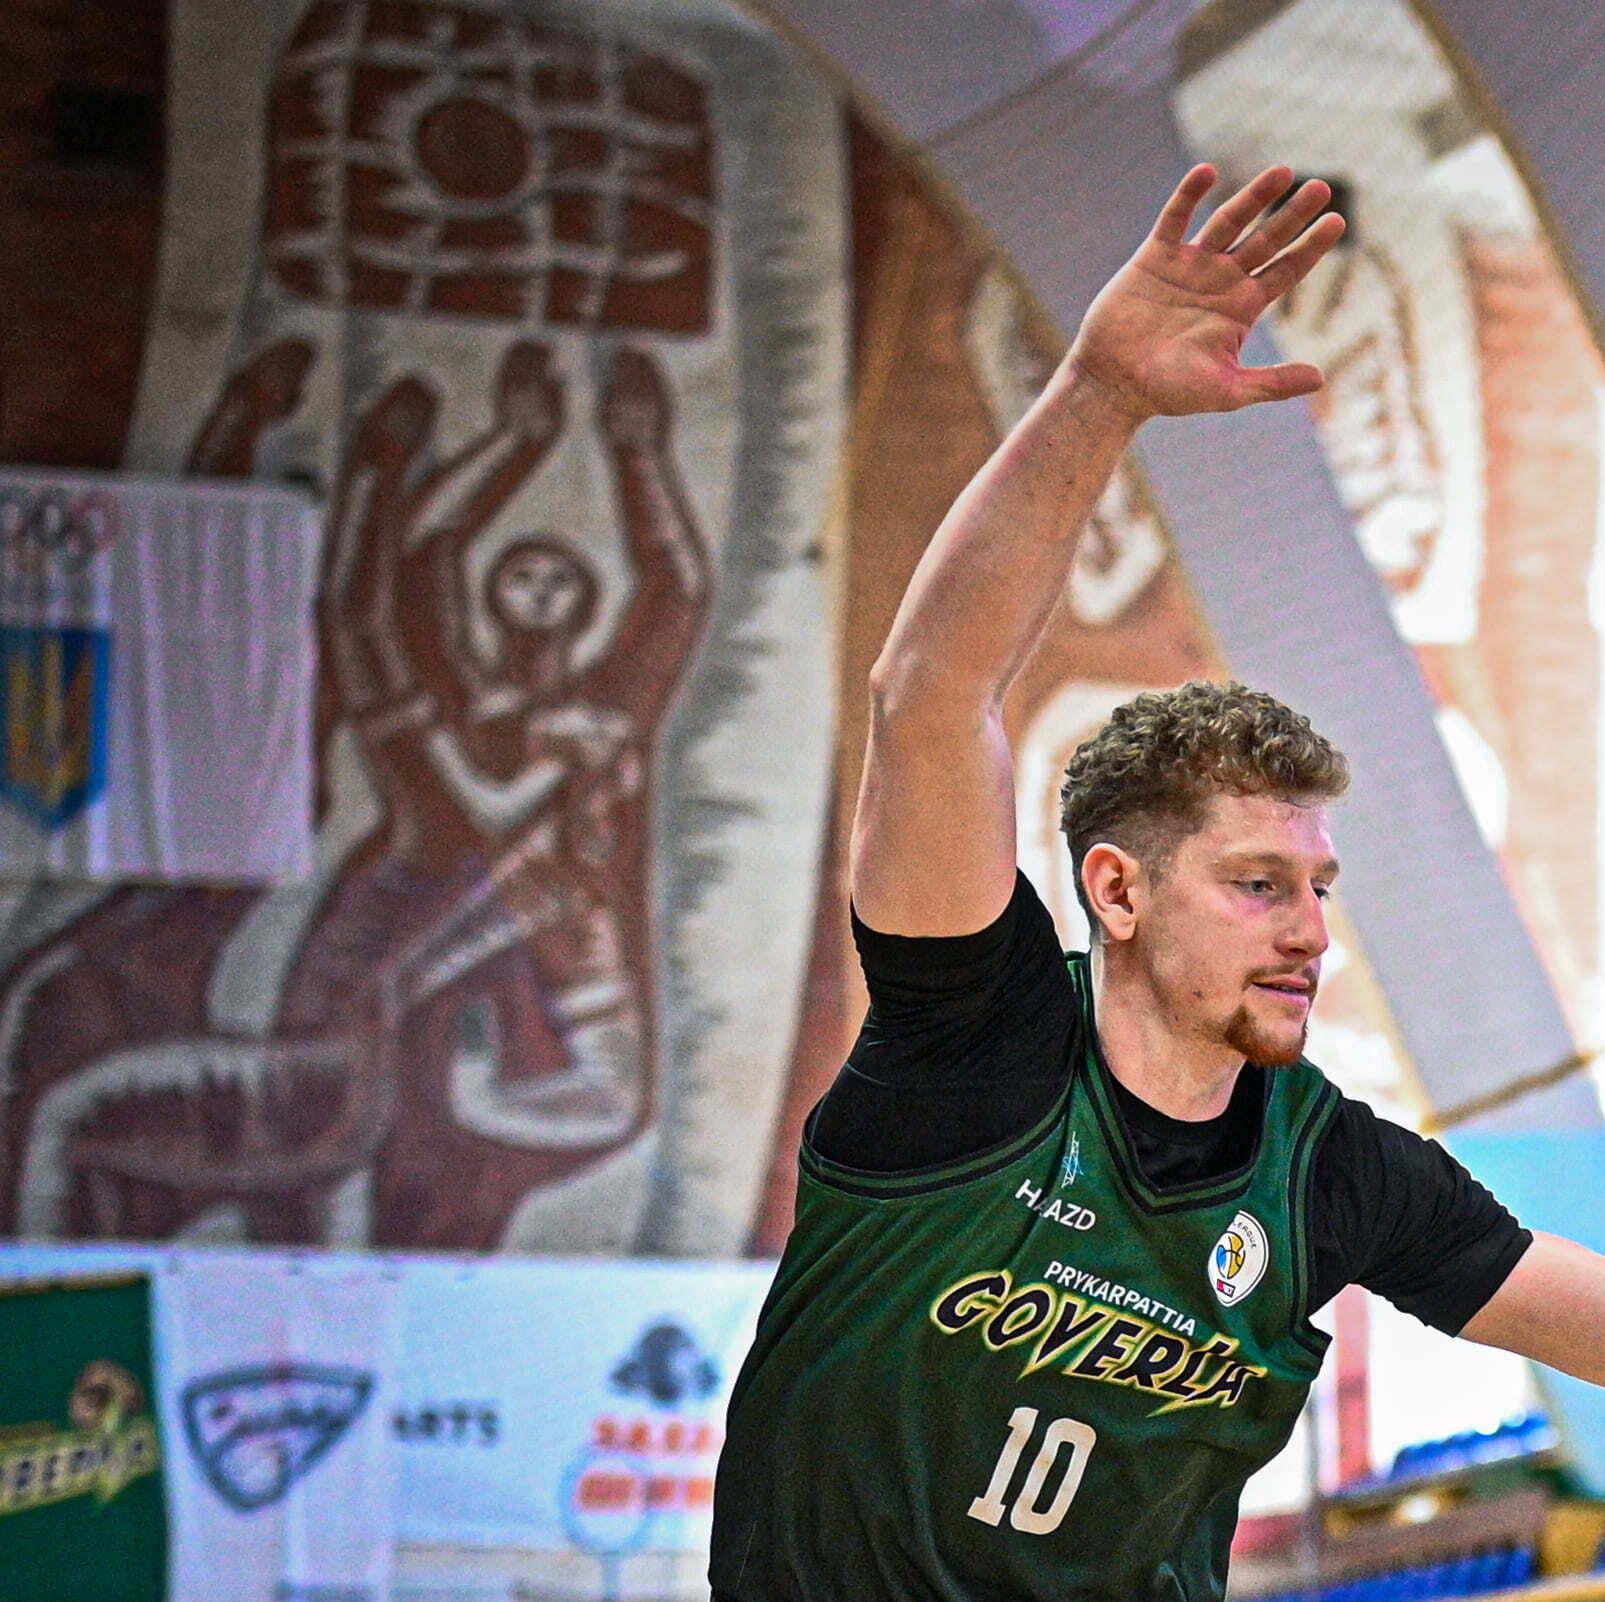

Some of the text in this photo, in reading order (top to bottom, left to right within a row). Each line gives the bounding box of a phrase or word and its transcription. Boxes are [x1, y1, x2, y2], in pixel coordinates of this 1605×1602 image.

[931, 1268, 1268, 1418] GOVERLA
[1044, 1260, 1195, 1337] PRYKARPATTIA
[966, 1406, 1097, 1535] 10
